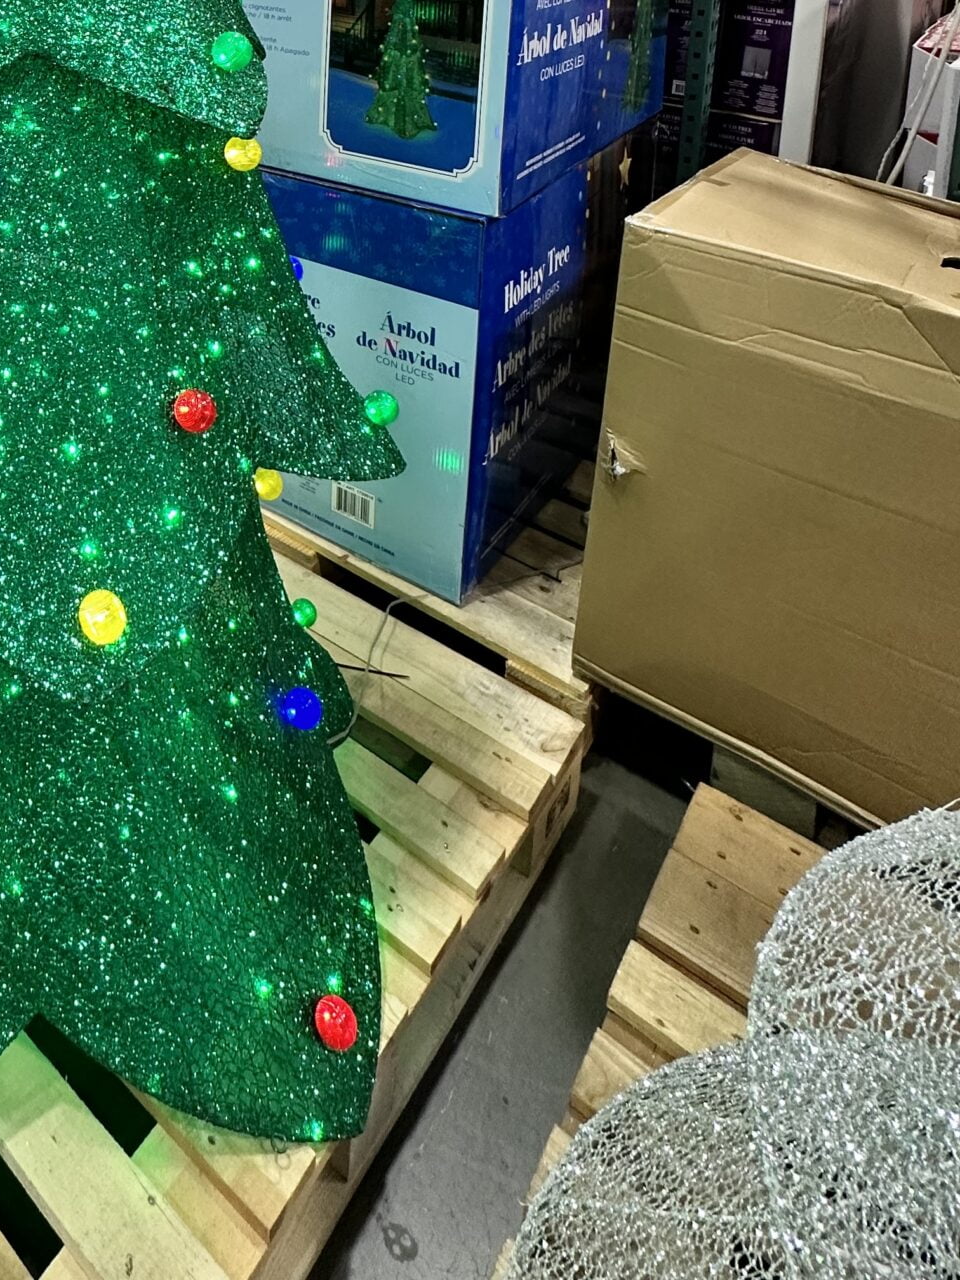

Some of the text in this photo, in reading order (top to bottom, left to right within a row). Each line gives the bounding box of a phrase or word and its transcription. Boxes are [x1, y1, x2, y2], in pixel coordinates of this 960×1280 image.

[516, 10, 603, 66] Árbol de Navidad
[540, 54, 585, 82] CON LUCES LED
[504, 244, 570, 314] Holiday Tree
[380, 310, 436, 346] Árbol
[356, 330, 460, 378] de Navidad
[376, 354, 434, 382] CON LUCES
[492, 347, 526, 393] Arbre
[396, 372, 415, 386] LED
